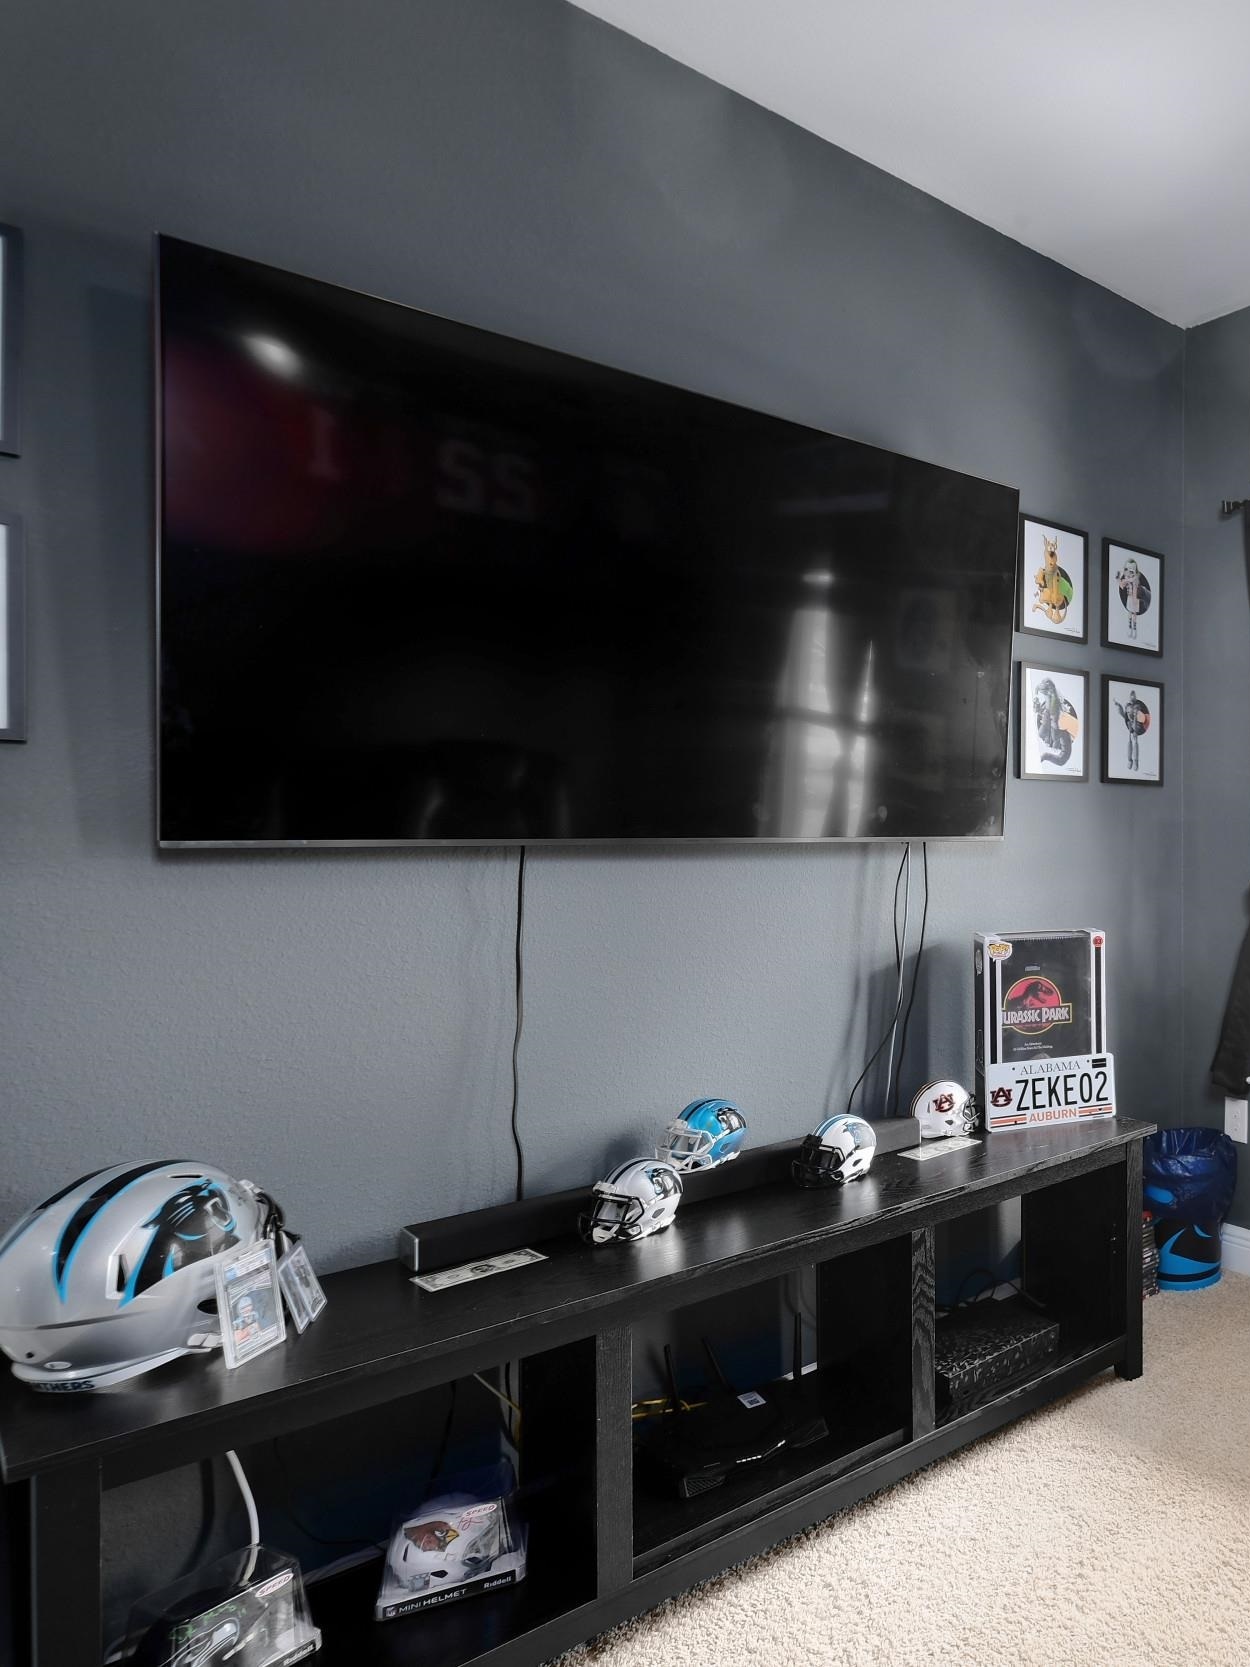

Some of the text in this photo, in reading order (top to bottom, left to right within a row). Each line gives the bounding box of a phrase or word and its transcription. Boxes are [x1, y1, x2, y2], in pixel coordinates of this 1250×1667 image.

[1002, 1007, 1070, 1024] URASSIC PARK
[1020, 1060, 1081, 1075] ALABAMA
[1015, 1071, 1109, 1111] ZEKE02
[1029, 1108, 1077, 1123] AUBURN
[34, 1380, 95, 1392] THERS
[465, 1504, 496, 1517] SPEED
[259, 1575, 290, 1595] SPEED
[483, 1576, 512, 1589] Riddell
[399, 1601, 421, 1614] MINI
[423, 1588, 467, 1606] HELMET
